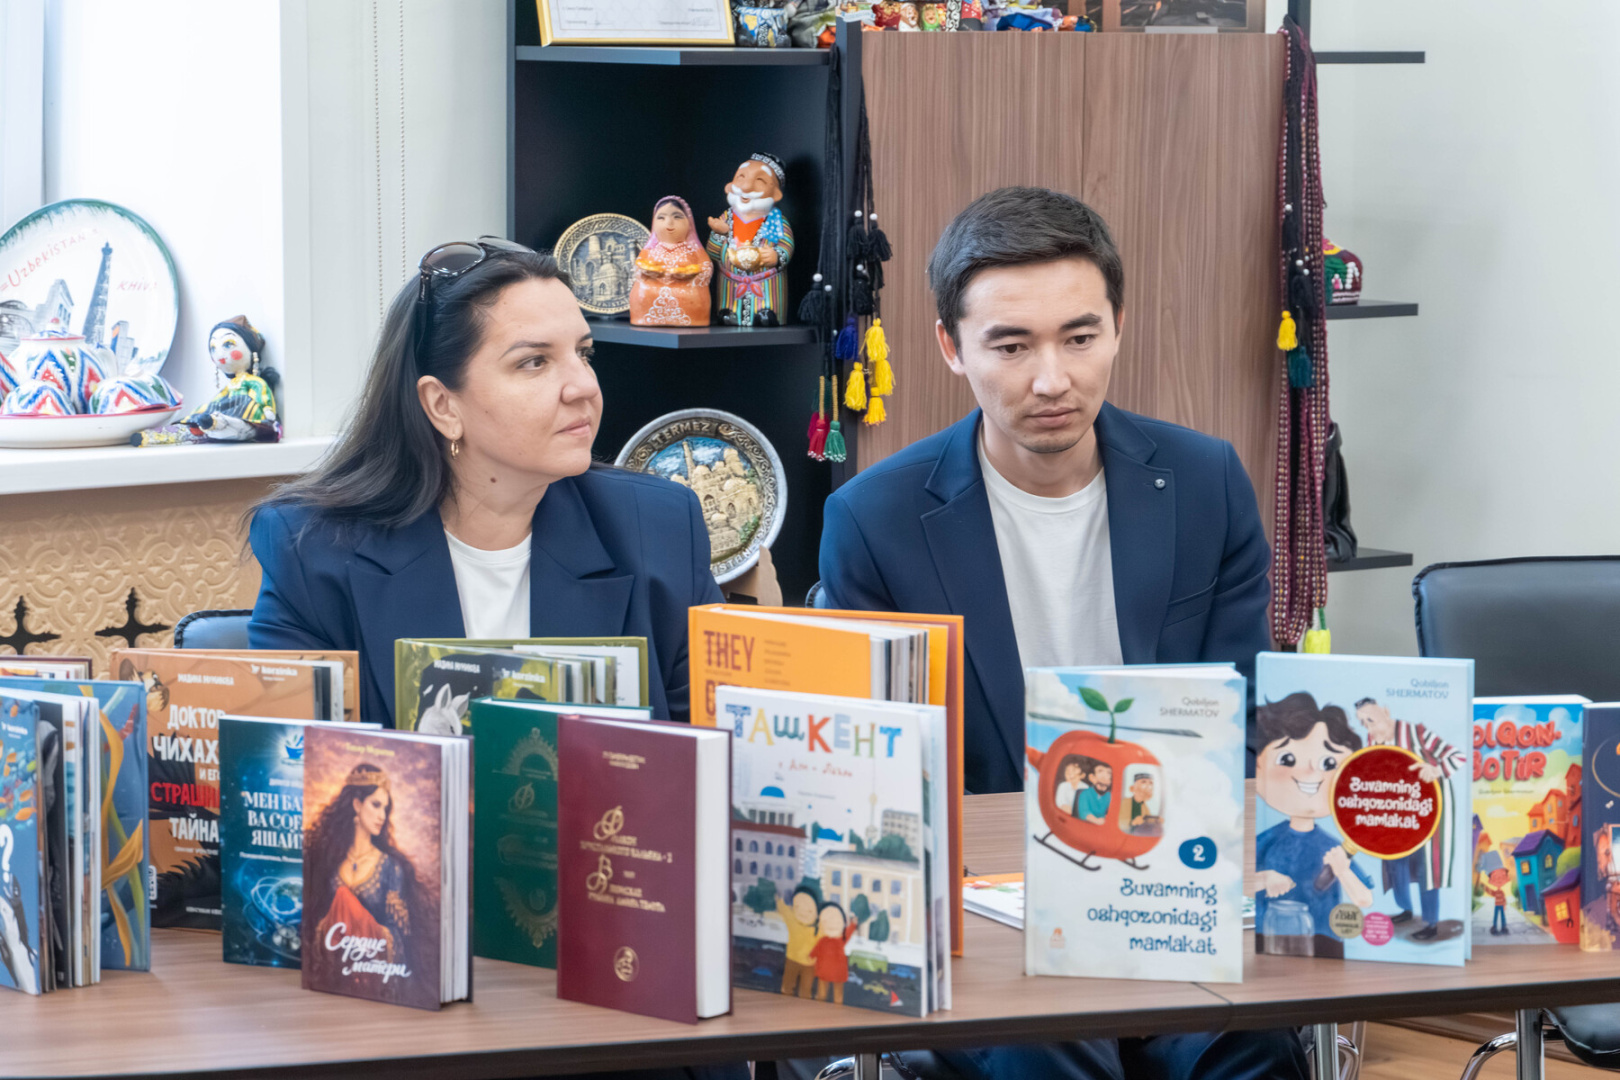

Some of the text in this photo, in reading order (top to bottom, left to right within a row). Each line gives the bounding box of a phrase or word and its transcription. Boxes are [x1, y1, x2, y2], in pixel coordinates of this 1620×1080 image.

[652, 421, 711, 446] TERMEZ
[703, 630, 755, 673] THEY
[1386, 688, 1450, 699] SHERMATOV
[1159, 707, 1220, 718] SHERMATOV
[208, 769, 220, 781] ЕГ
[1349, 776, 1421, 799] Buvamning
[1337, 794, 1433, 817] oshqozonidagi
[169, 813, 219, 843] ТАЙНА
[248, 810, 268, 828] ВА
[1355, 813, 1420, 831] mamlakat
[1192, 844, 1206, 862] 2
[1120, 878, 1218, 906] Buvamning
[1087, 904, 1218, 933] oshqozonidagi
[325, 921, 388, 963] Сердце
[1129, 935, 1218, 956] mamlakat
[342, 959, 412, 984] матери
